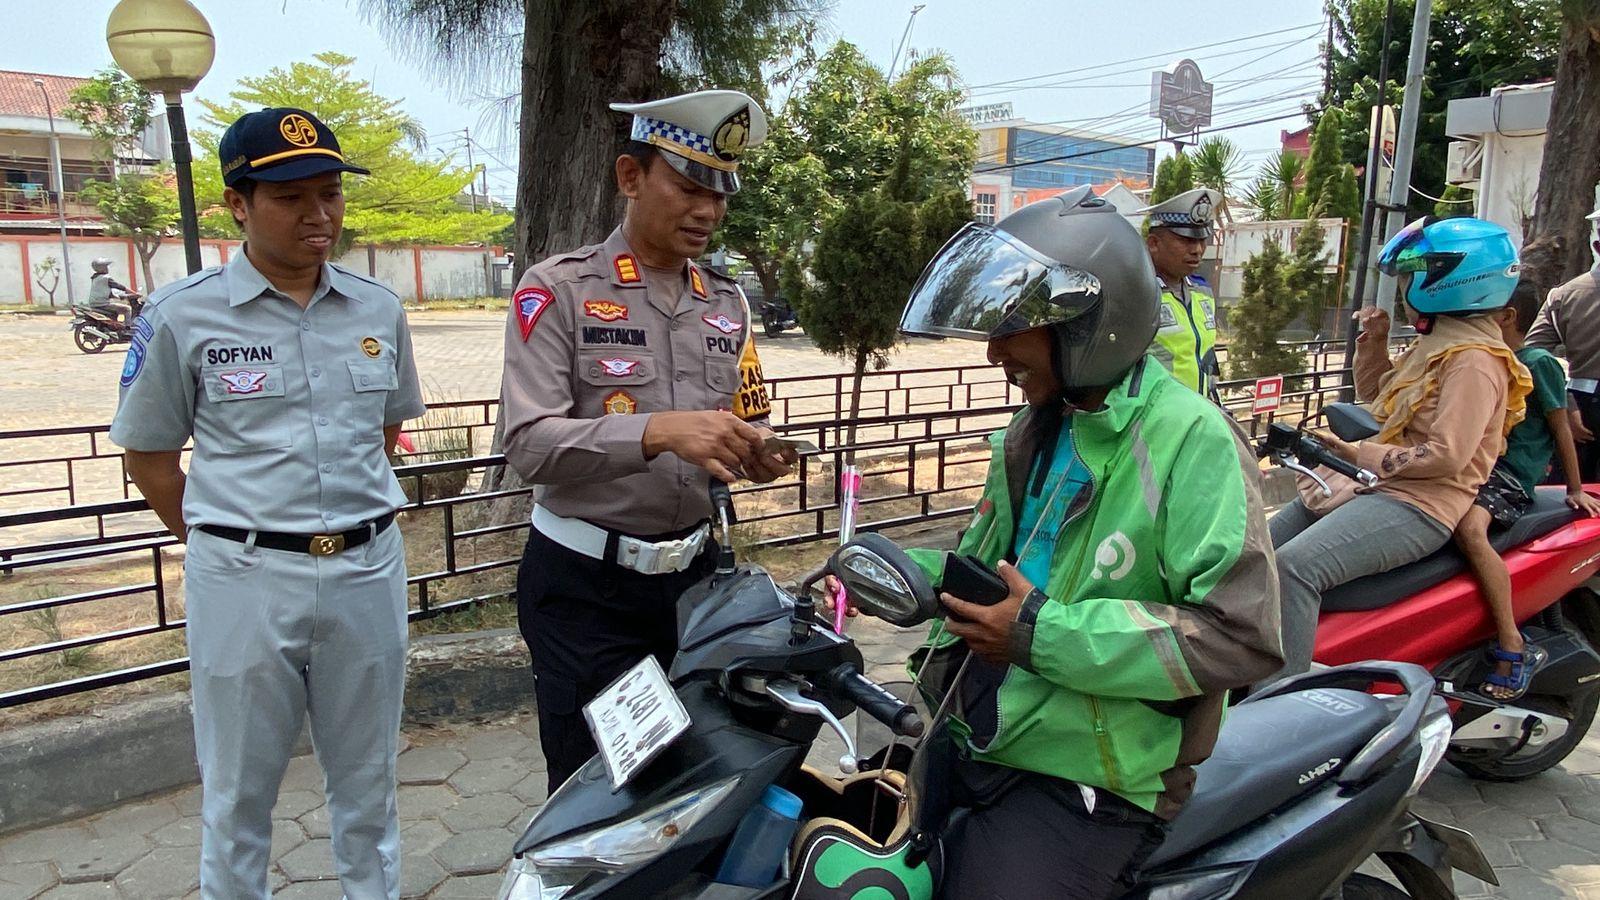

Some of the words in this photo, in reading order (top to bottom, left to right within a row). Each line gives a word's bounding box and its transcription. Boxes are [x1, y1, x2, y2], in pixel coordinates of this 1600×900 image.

[582, 326, 647, 346] MUSTAKIM
[207, 345, 273, 365] SOFYAN
[705, 336, 740, 357] POL
